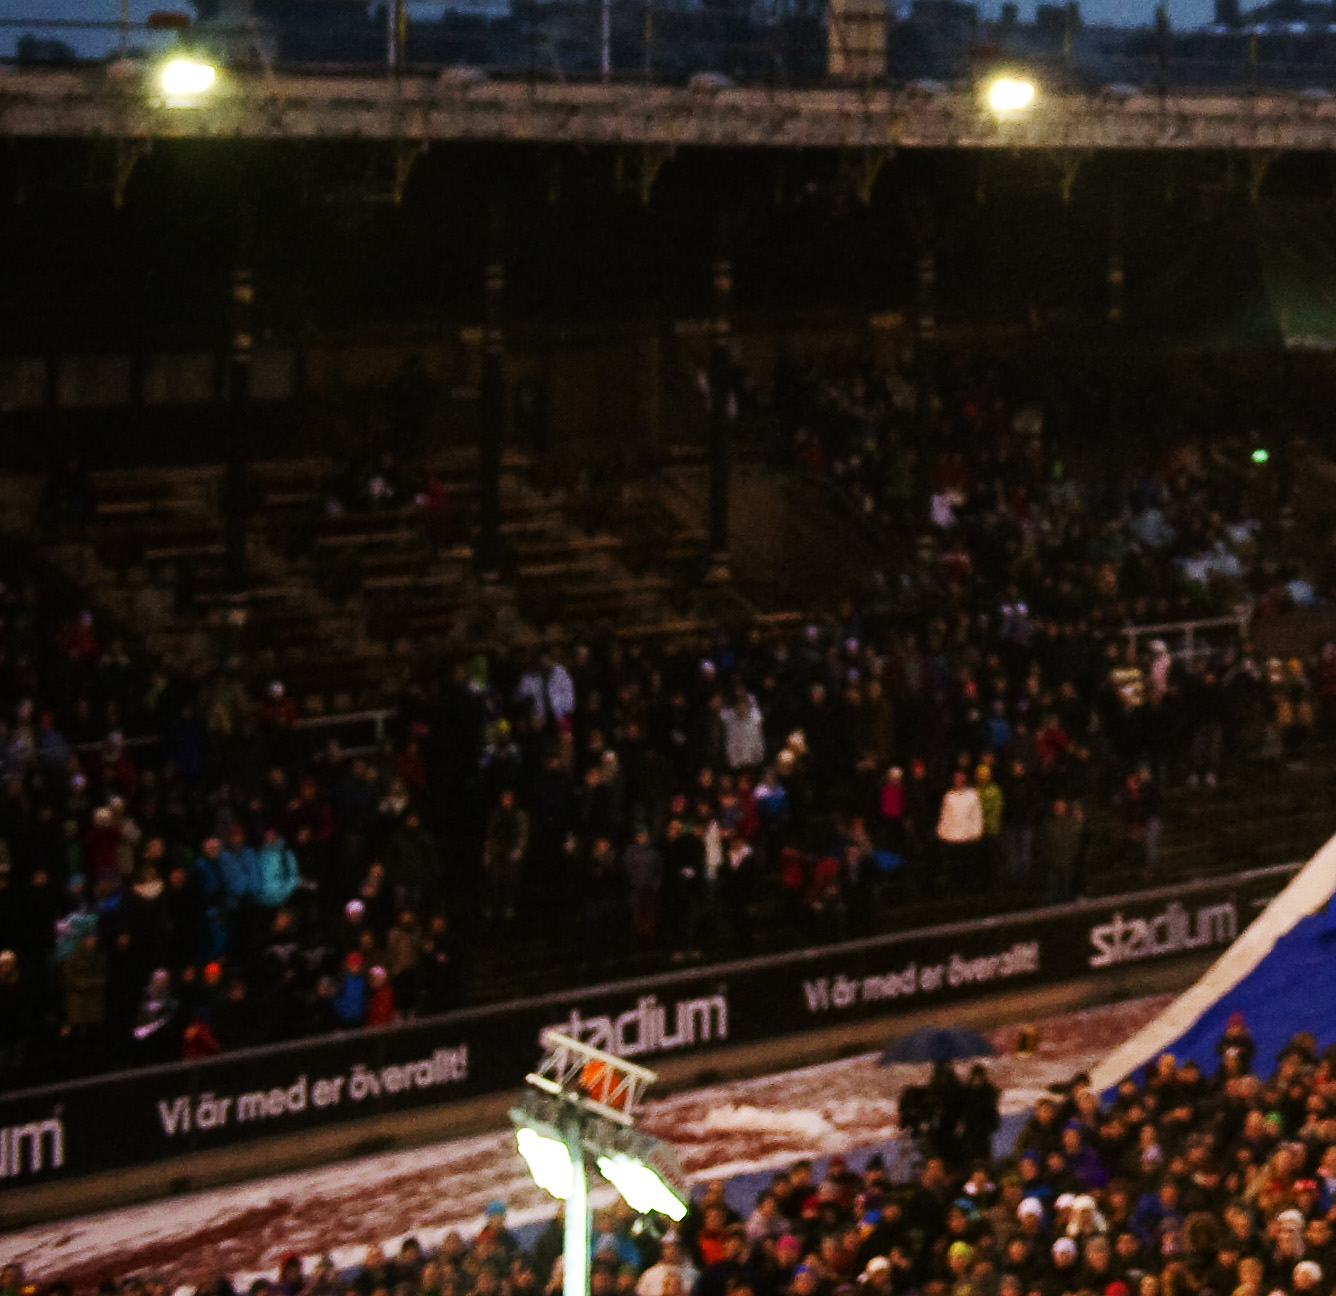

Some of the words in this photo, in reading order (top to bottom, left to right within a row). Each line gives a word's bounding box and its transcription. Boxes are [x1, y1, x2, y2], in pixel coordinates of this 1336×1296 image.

[1089, 902, 1238, 968] stadium
[158, 1095, 192, 1136] Vi
[236, 1074, 308, 1122] med
